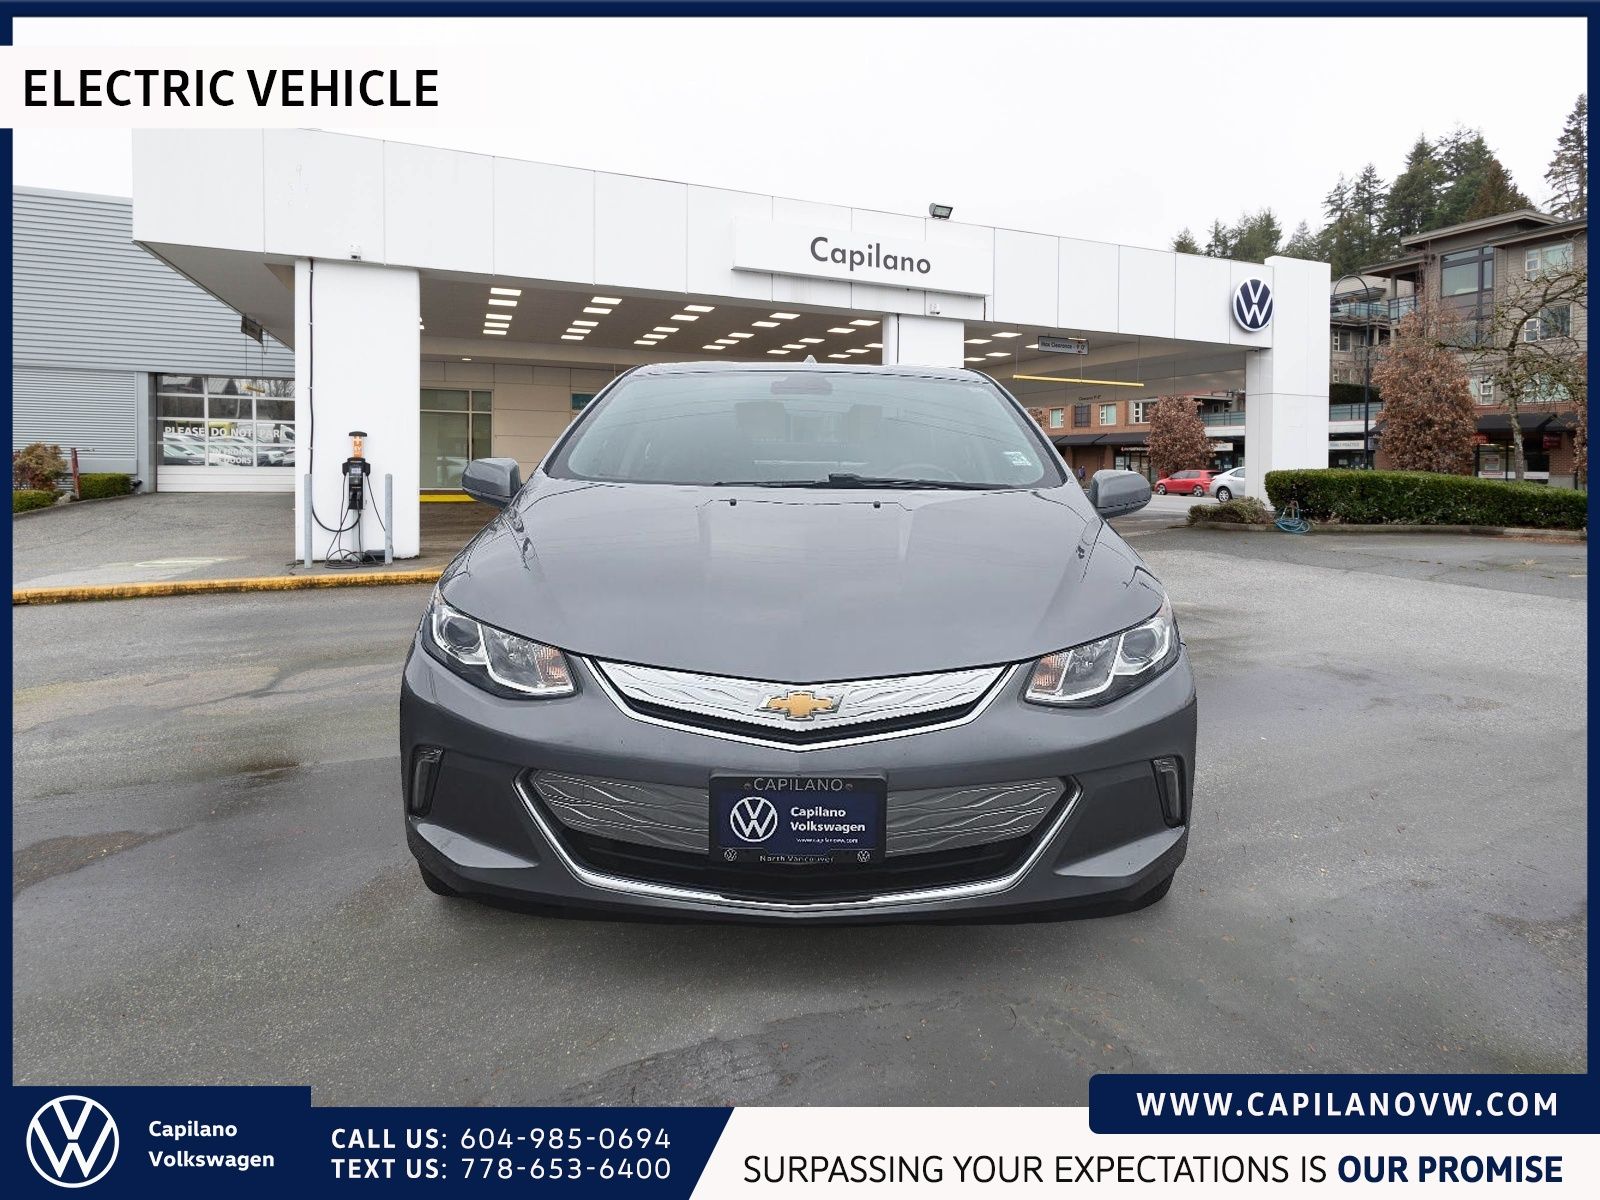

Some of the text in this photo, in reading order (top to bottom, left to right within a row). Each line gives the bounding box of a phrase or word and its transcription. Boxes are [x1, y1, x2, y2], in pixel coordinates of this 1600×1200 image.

[810, 236, 931, 274] Capilano
[165, 426, 205, 435] PLEASE
[211, 428, 227, 437] DO
[231, 428, 253, 437] NOT
[753, 778, 844, 791] CAPILANO
[790, 806, 847, 818] Capilano
[790, 821, 866, 834] Volkswagen
